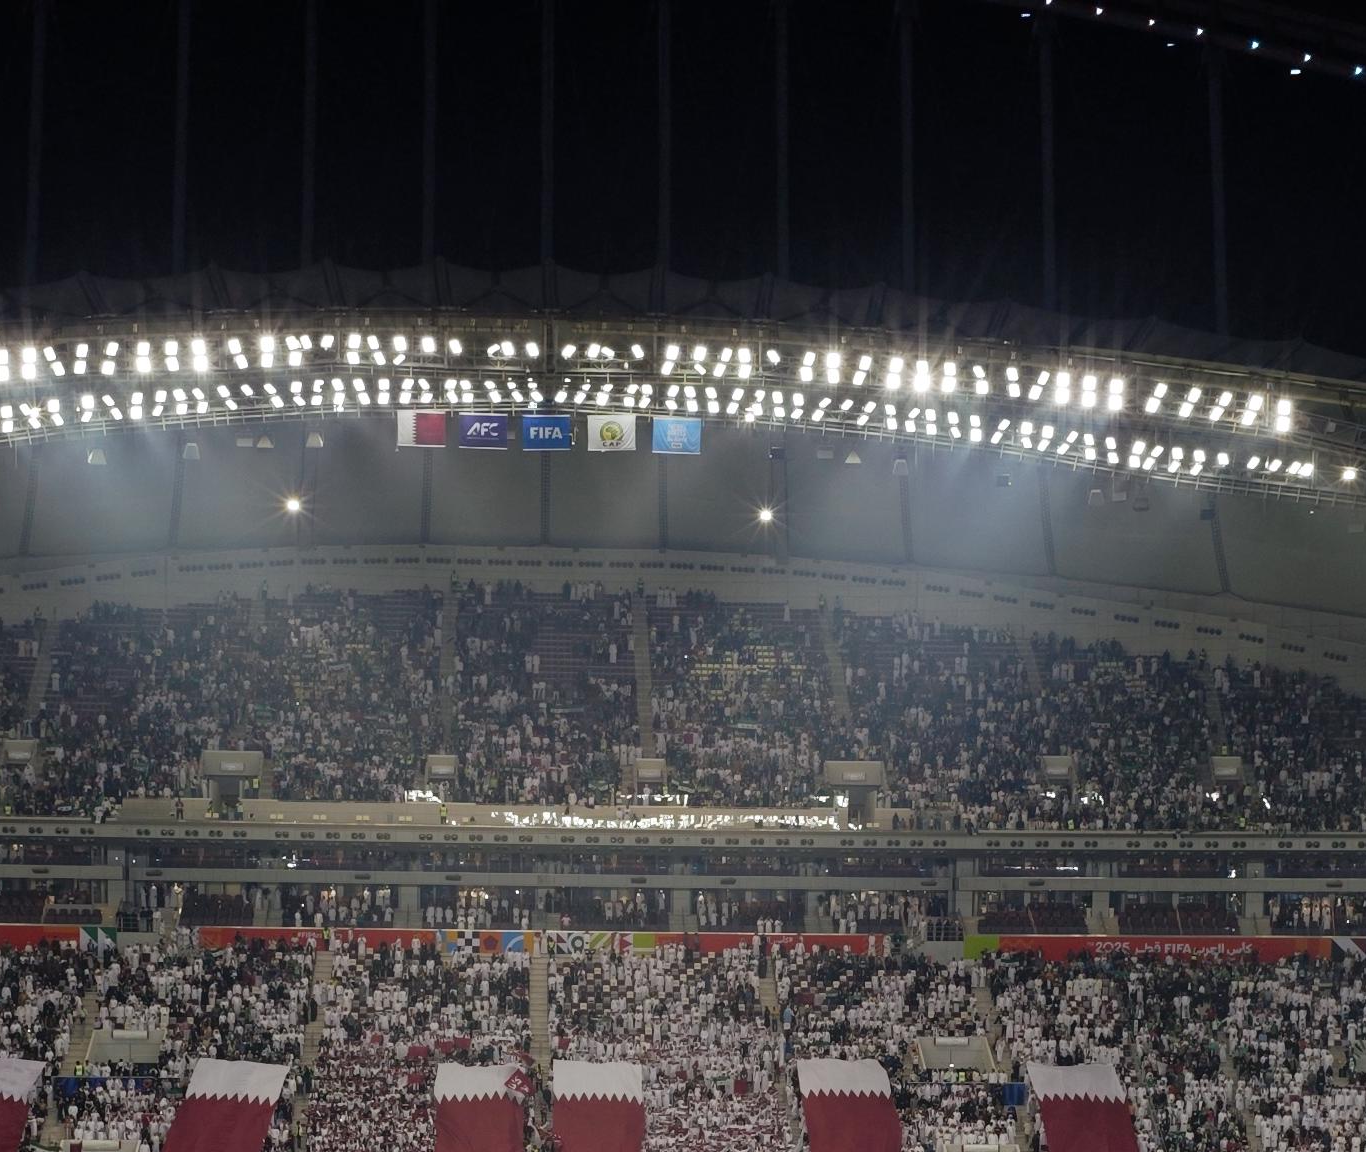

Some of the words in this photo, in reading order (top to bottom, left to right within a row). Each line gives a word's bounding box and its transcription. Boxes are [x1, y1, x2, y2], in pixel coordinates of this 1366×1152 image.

[467, 422, 499, 436] AFC
[529, 427, 563, 439] FIFA
[1163, 943, 1192, 954] FIFA
